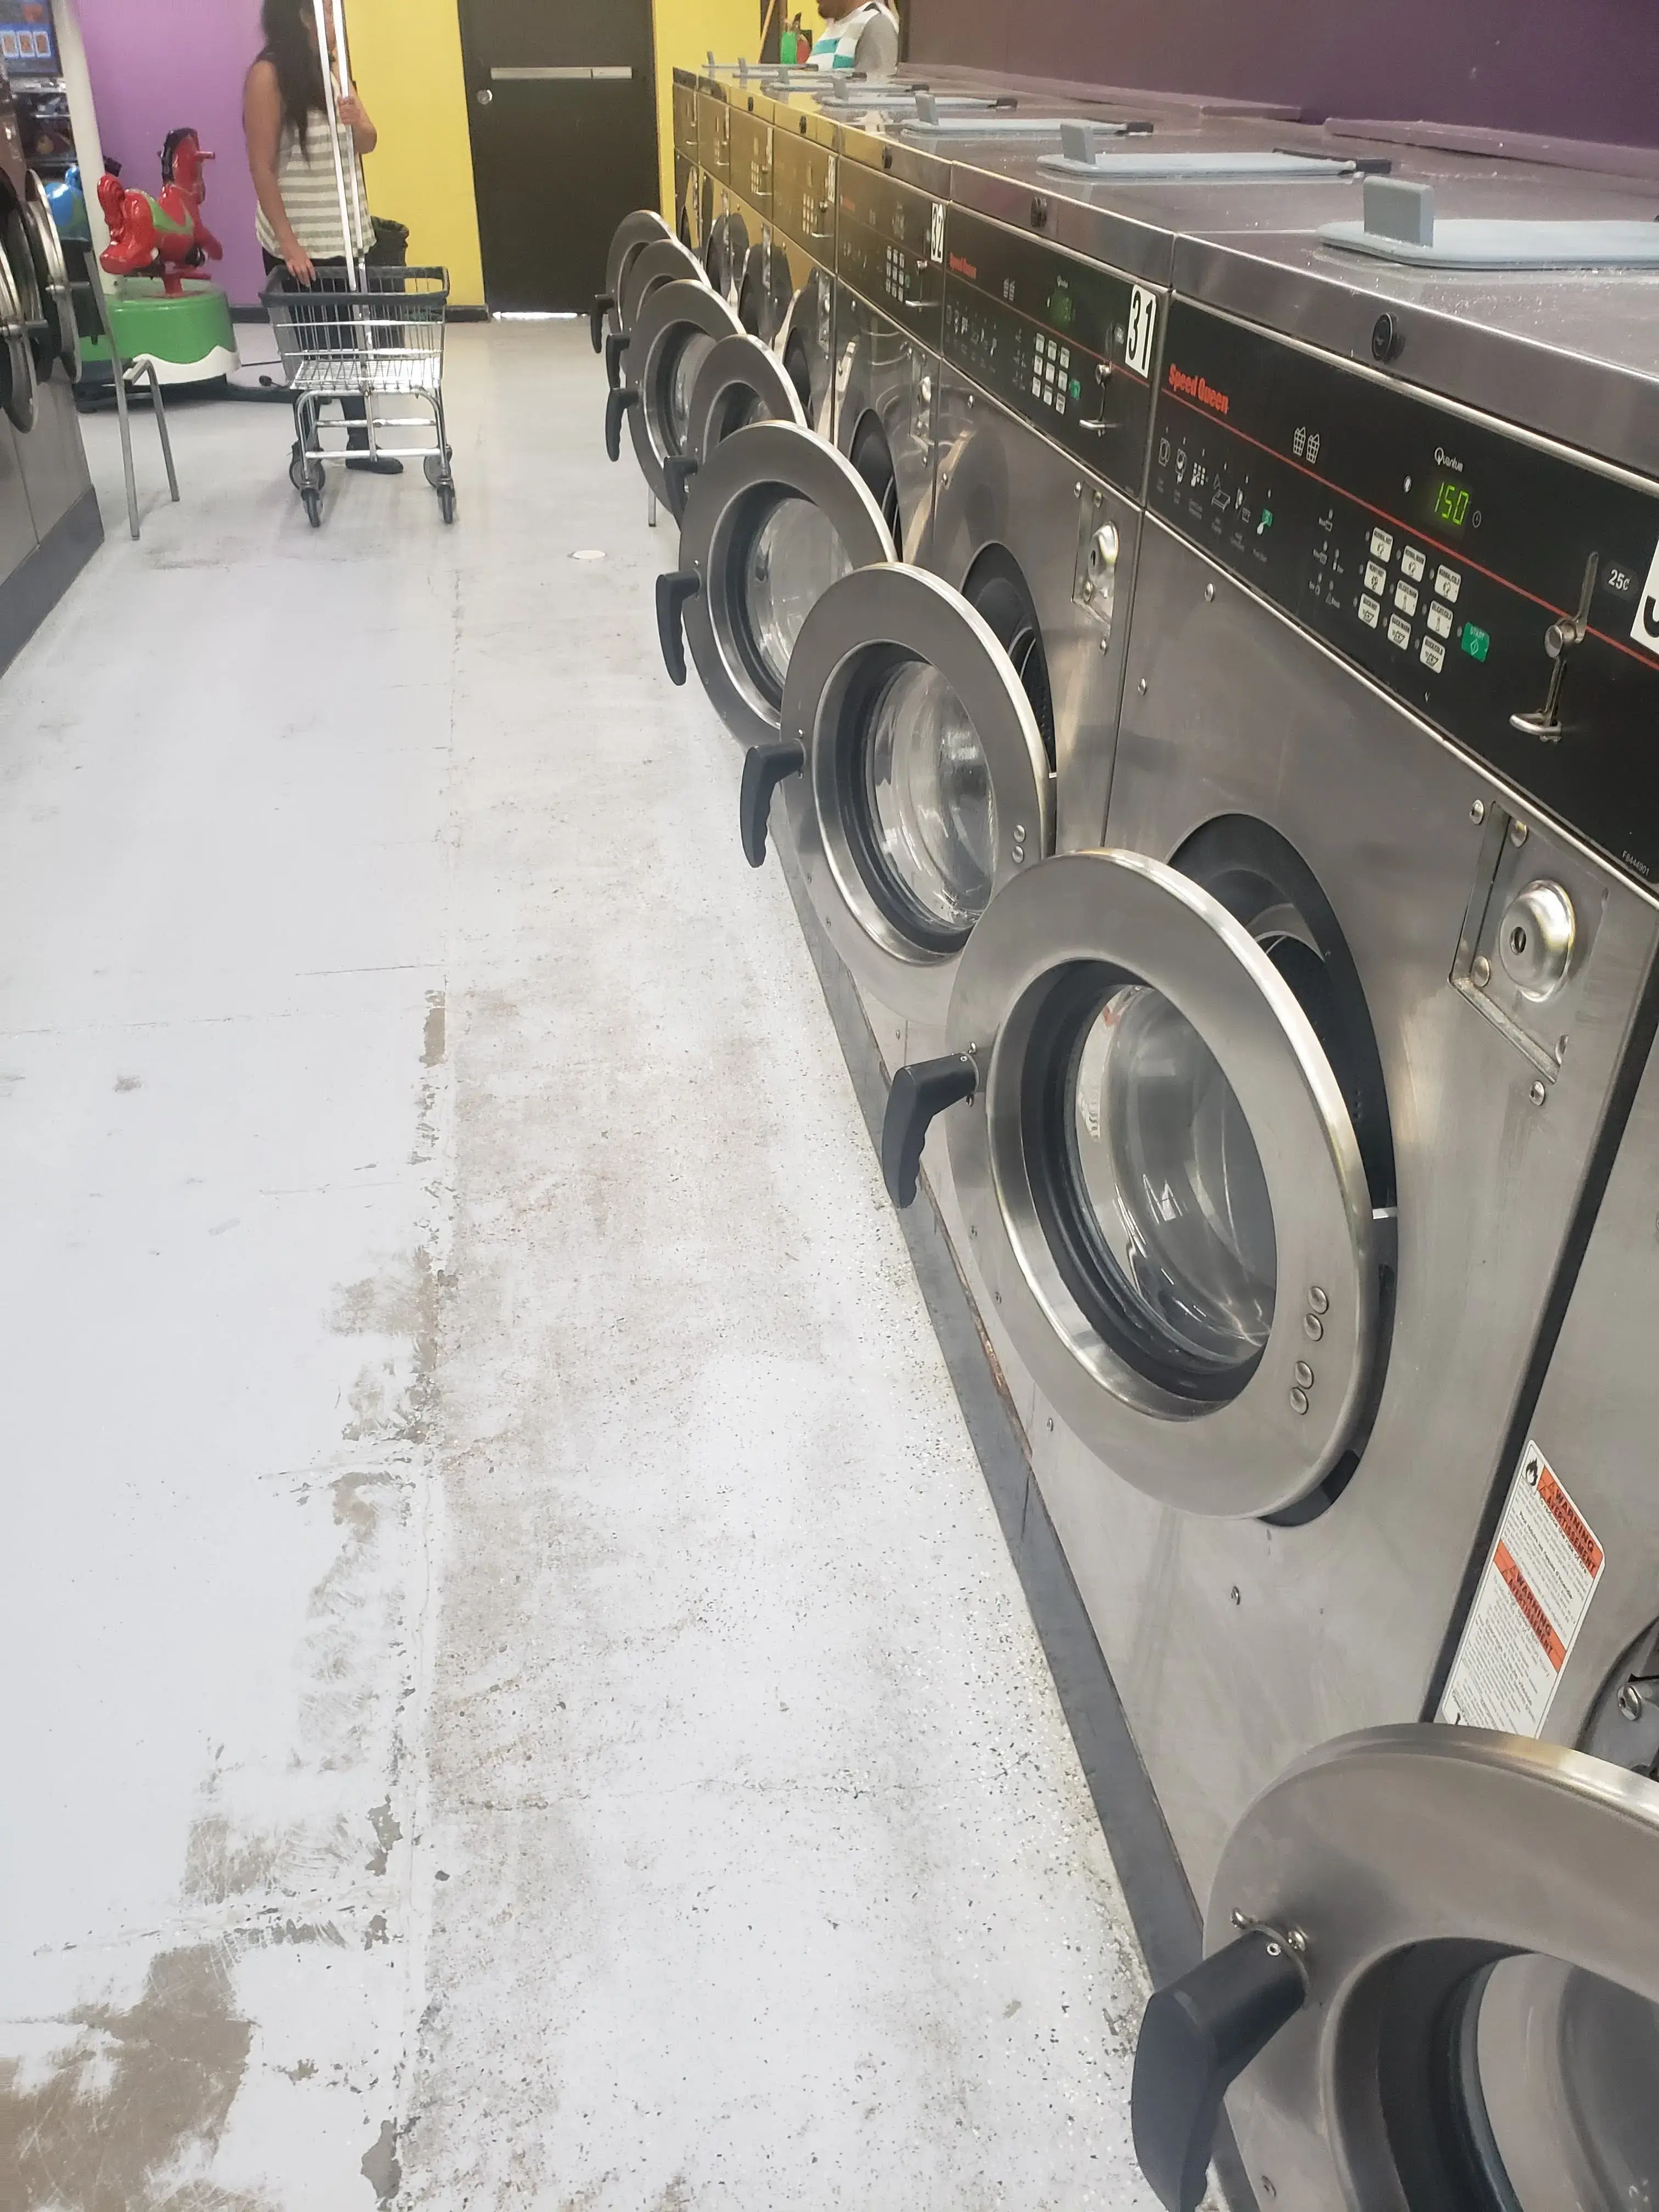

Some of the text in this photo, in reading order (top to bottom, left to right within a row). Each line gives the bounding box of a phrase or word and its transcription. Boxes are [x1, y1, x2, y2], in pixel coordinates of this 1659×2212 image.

[933, 206, 943, 258] 32
[1128, 290, 1153, 371] 31
[1169, 363, 1228, 414] Speed Queen
[1435, 447, 1463, 472] Quantum
[1435, 482, 1469, 525] 150
[1547, 1493, 1595, 1575] AVERTISSEMENT
[1555, 1487, 1594, 1554] WARNING
[1516, 1572, 1552, 1637] WARNING
